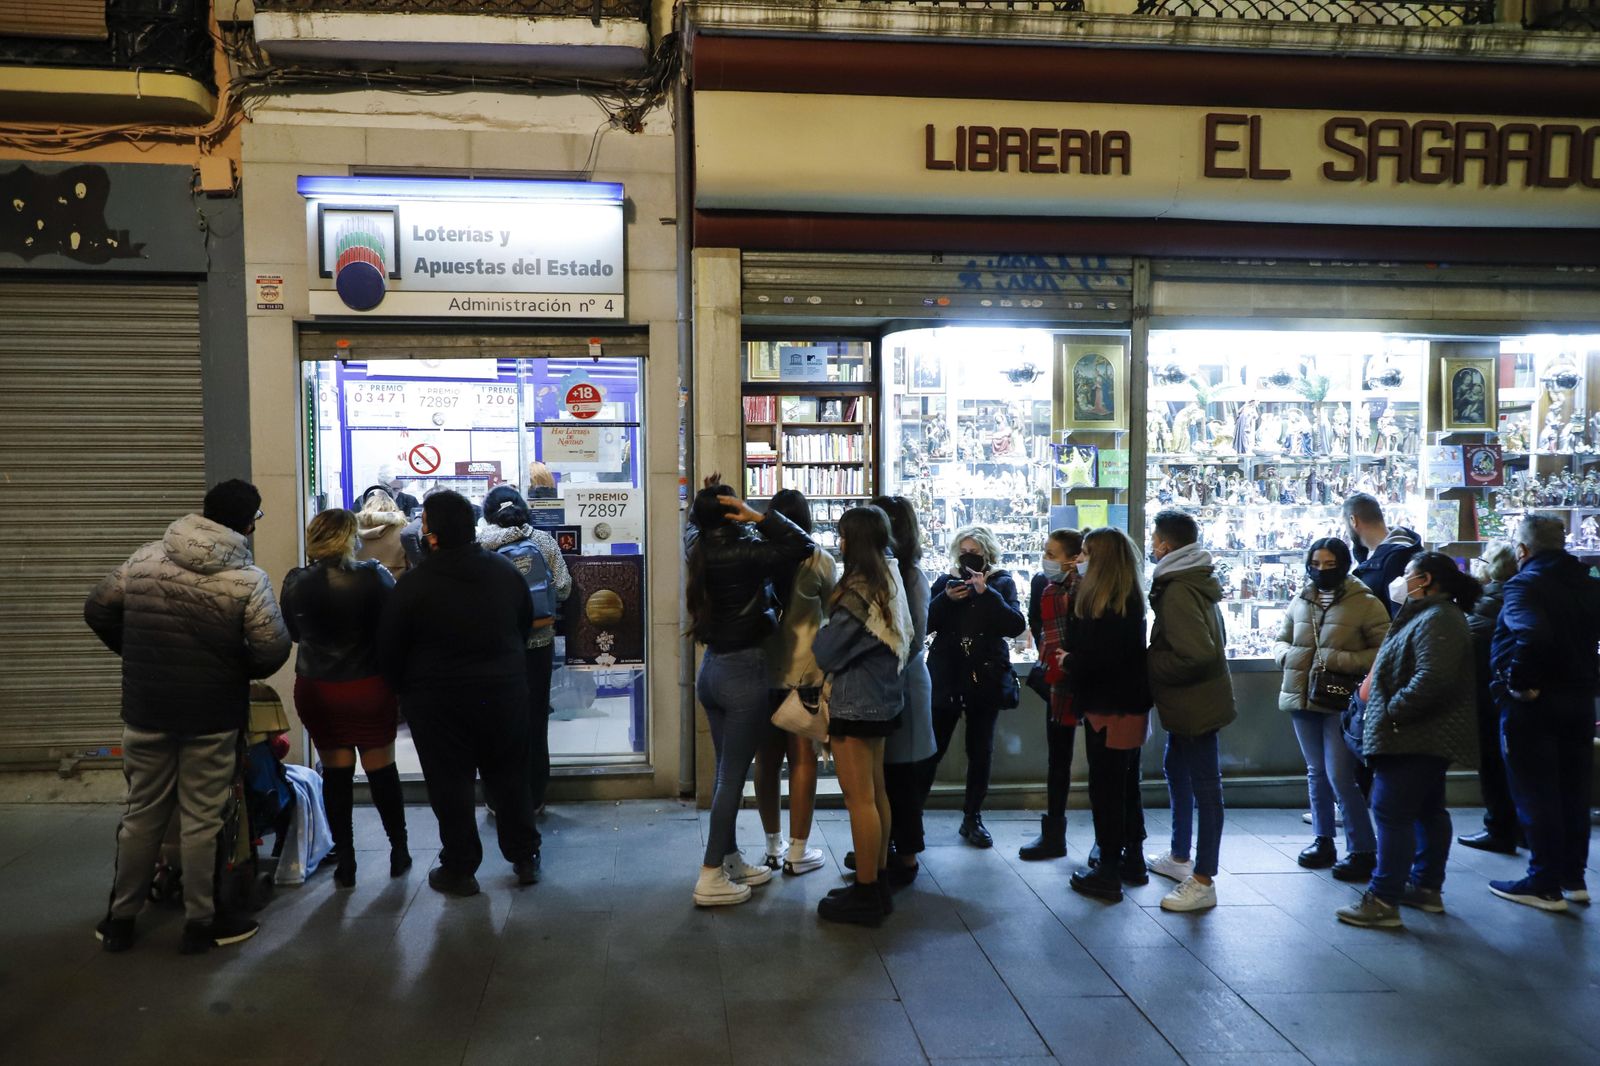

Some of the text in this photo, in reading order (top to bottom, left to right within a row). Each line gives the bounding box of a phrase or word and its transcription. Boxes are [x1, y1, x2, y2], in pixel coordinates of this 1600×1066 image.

[926, 124, 1131, 175] LIBRERIA
[1204, 112, 1290, 180] EL
[412, 225, 510, 247] Loterías y
[414, 257, 614, 278] Apuestas del Estado
[448, 297, 570, 312] Administración
[604, 299, 614, 312] 4
[354, 392, 405, 403] 03471
[572, 387, 593, 398] +18
[419, 396, 458, 408] 72897
[578, 504, 626, 517] 72897
